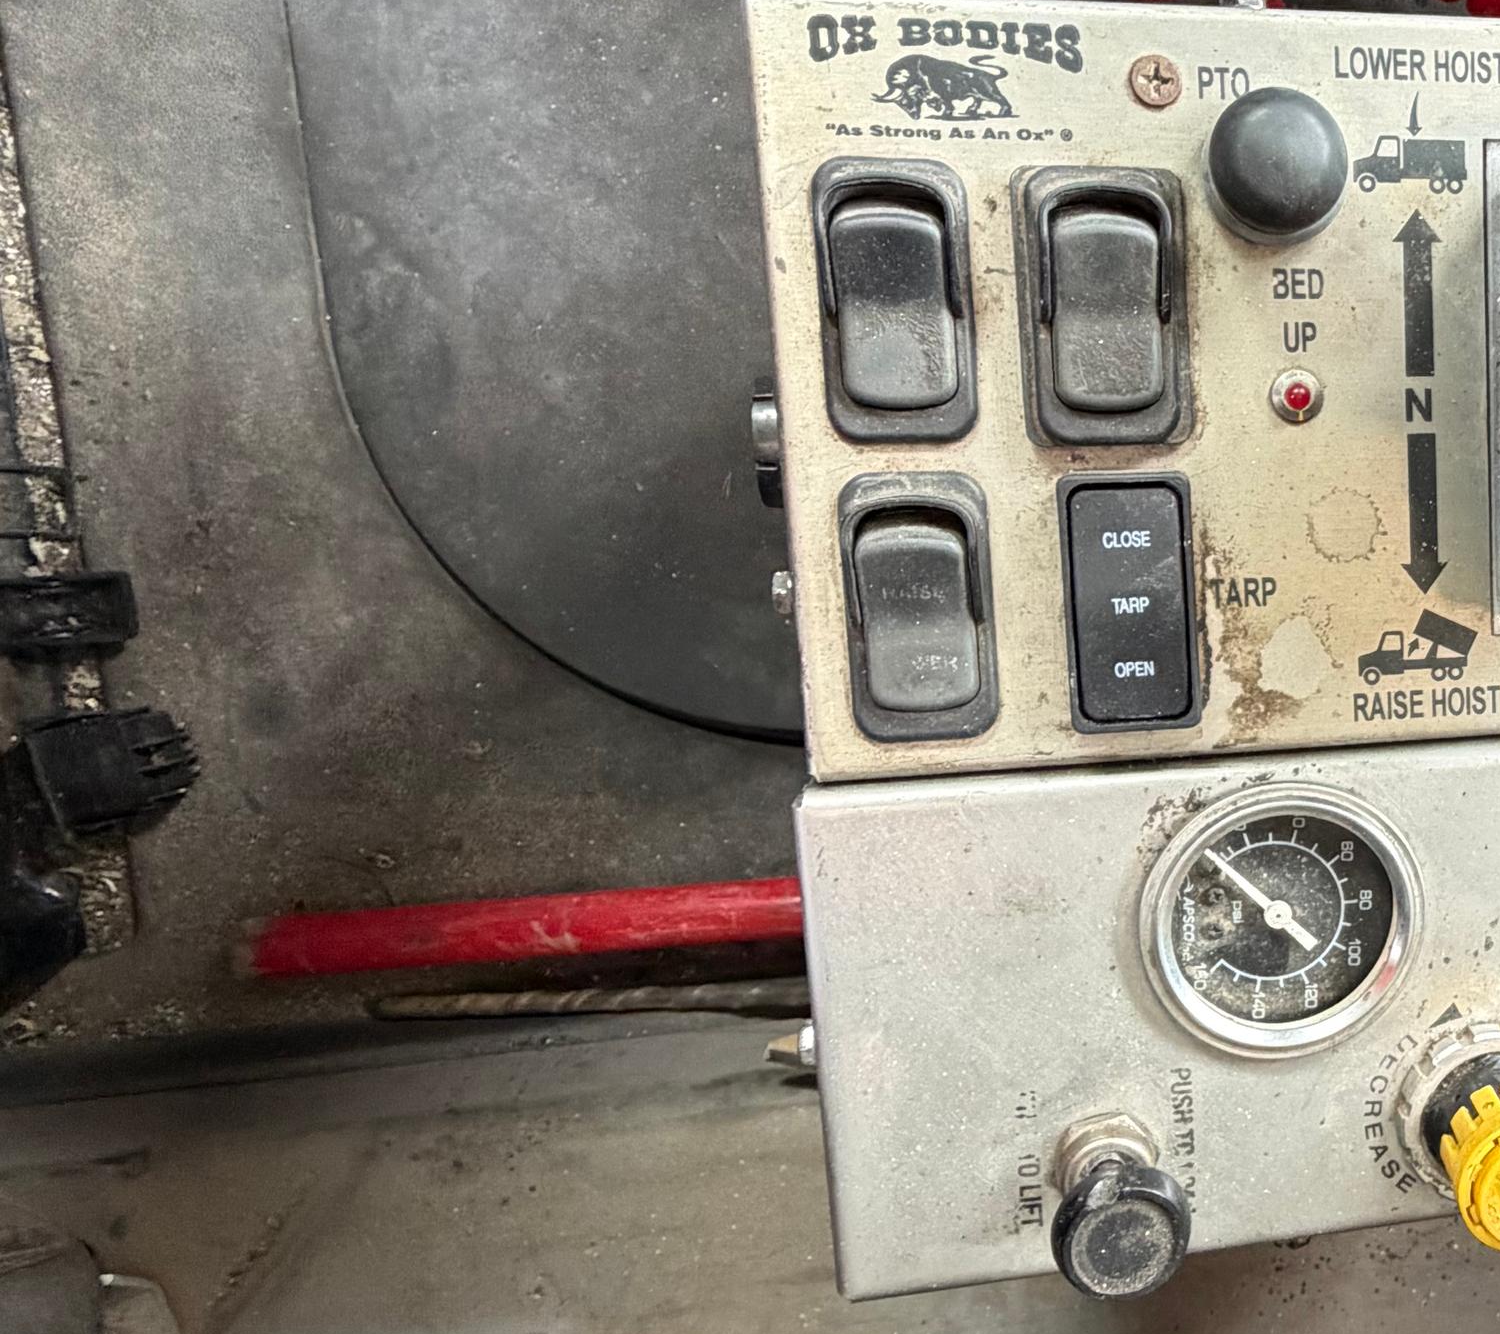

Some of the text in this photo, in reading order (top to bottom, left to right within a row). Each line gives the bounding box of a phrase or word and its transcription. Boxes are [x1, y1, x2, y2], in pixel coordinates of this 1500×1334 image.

[806, 13, 1084, 74] OX BODIES
[1334, 46, 1425, 82] LOWER
[1197, 66, 1250, 100] PTO
[869, 124, 942, 142] Strong
[948, 127, 976, 140] As
[982, 127, 1010, 141] An
[1272, 267, 1324, 300] BED
[1283, 321, 1317, 354] UP
[1405, 388, 1433, 422] N
[1102, 531, 1151, 549] CLOSE
[1111, 596, 1150, 615] TARP
[1208, 577, 1277, 608] TARP
[1114, 661, 1155, 679] OPEN
[1353, 684, 1500, 723] RAISE HOIST
[1341, 841, 1354, 862] 60
[1231, 900, 1245, 924] psi
[1359, 889, 1373, 911] 80
[1347, 938, 1362, 966] 100
[1252, 991, 1266, 1019] 140
[1304, 982, 1319, 1010] 120
[1018, 1184, 1044, 1228] LIFT
